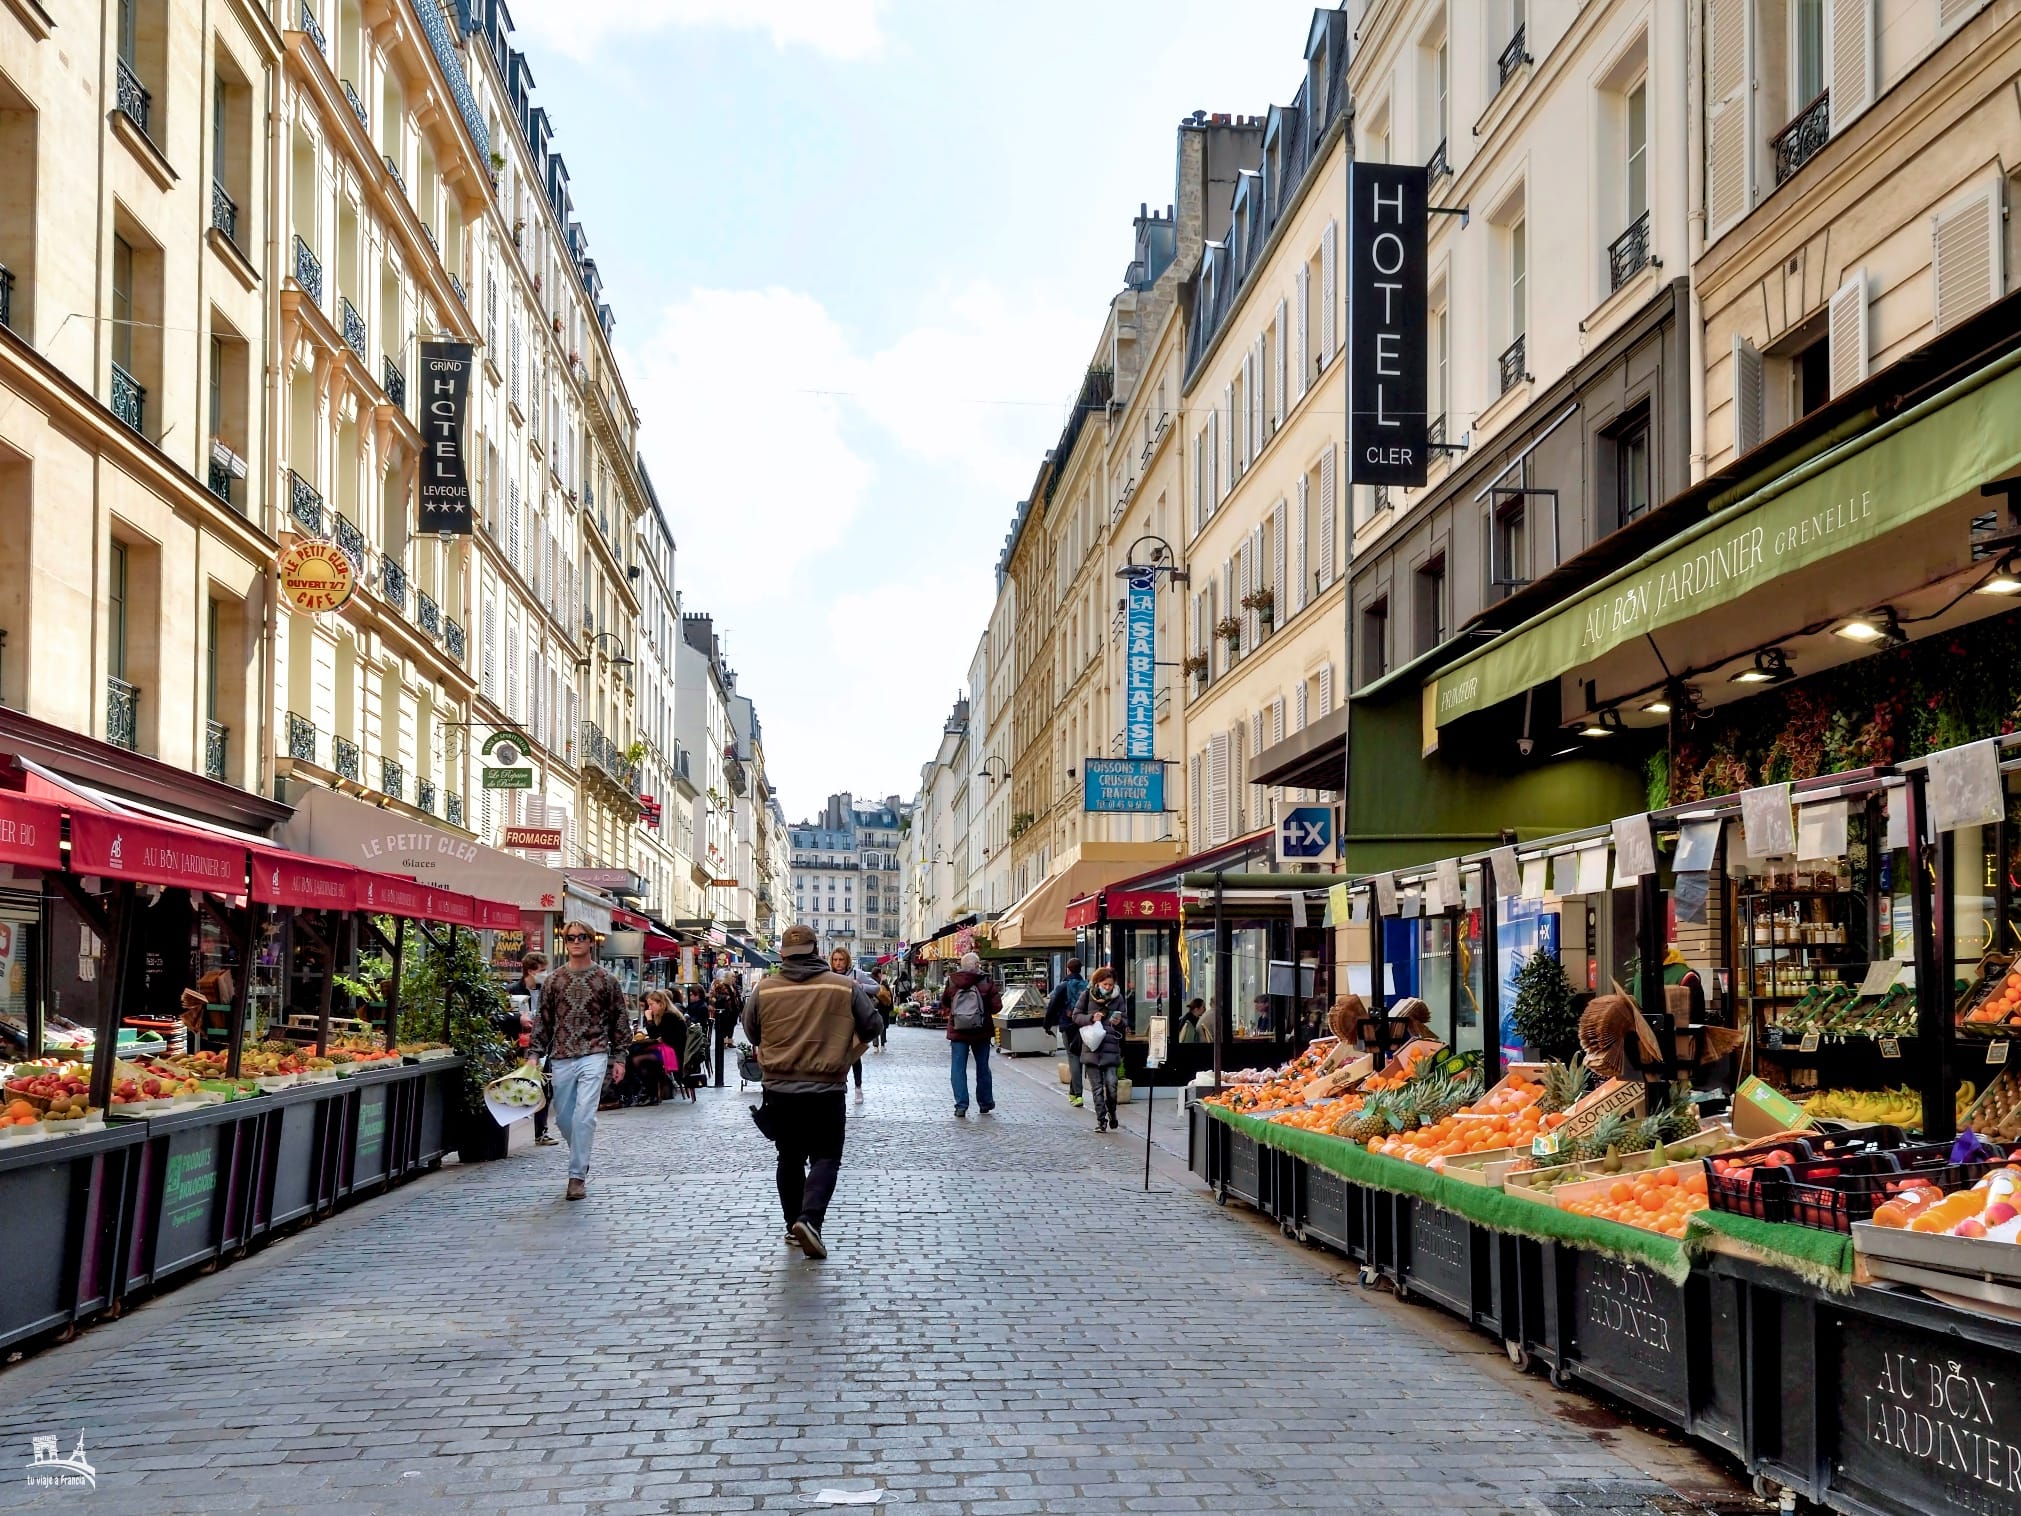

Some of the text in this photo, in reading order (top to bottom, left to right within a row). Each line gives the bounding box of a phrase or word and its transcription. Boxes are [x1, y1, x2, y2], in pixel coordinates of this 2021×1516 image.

[1372, 182, 1404, 426] HOTEL
[431, 379, 456, 478] HOTEL
[1366, 447, 1413, 465] CLER
[423, 486, 467, 497] LEVEQUE
[296, 545, 327, 561] PETIT
[1582, 605, 1608, 648] AU
[1654, 526, 1764, 616] JARDINIER
[1774, 490, 1873, 556] GRENELLE
[287, 579, 346, 590] OUVERT 7/7
[296, 591, 336, 609] CAFE
[1130, 594, 1153, 610] LA
[1131, 622, 1149, 756] SABLAISE
[1087, 761, 1160, 775] POISSONS FINS
[1101, 787, 1147, 799] TRAITEUR
[20, 823, 36, 847] BIO
[506, 831, 561, 846] FROMAGER
[361, 833, 478, 863] LE PETIT CLER
[143, 847, 157, 866] AU
[180, 852, 220, 877] JARDINIER
[402, 857, 436, 869] Glaces
[495, 942, 523, 951] AWAY
[1586, 1289, 1671, 1353] JARDINIER
[1877, 1352, 1918, 1399] AU
[1864, 1396, 2021, 1493] JARDINIER
